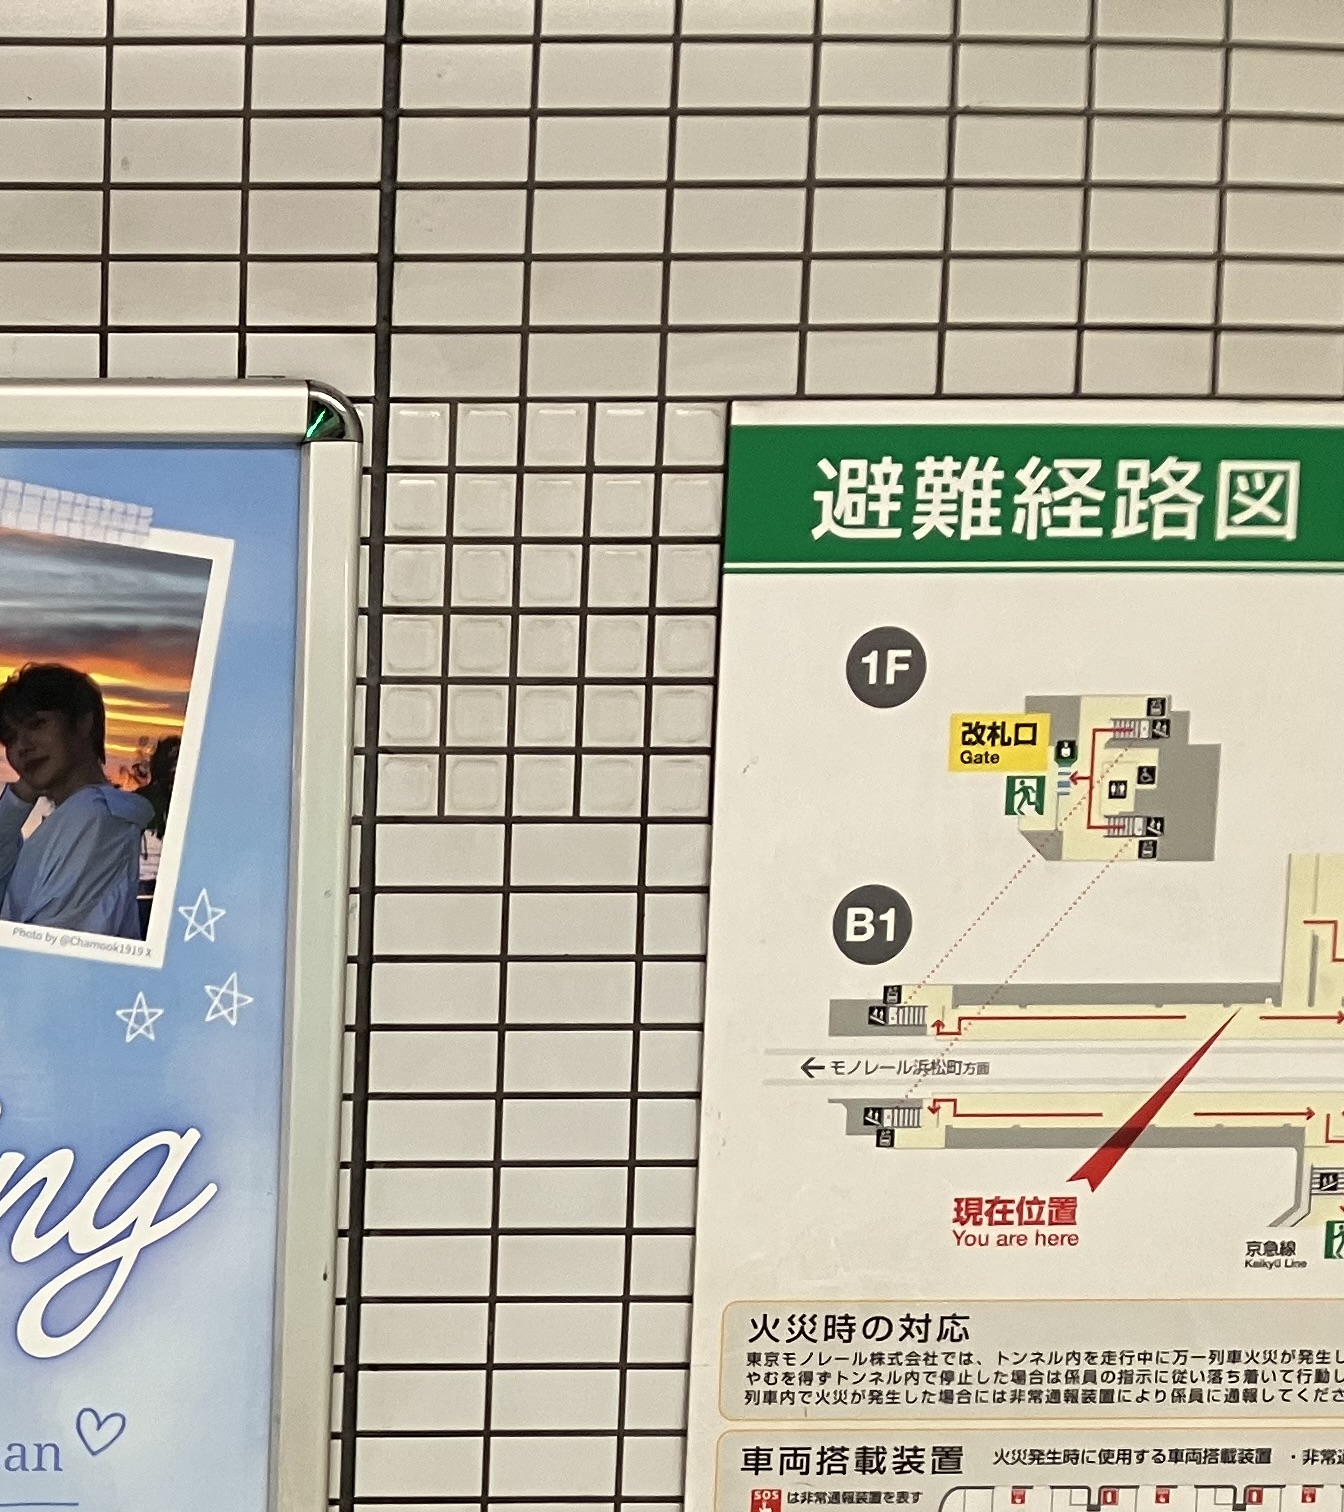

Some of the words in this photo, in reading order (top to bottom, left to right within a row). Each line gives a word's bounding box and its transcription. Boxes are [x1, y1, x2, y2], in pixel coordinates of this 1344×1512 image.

[811, 455, 1301, 542] 避難経路図
[861, 649, 913, 684] 1F
[961, 721, 1037, 747] 改札口
[959, 750, 1000, 765] Gate
[12, 926, 42, 941] Photo
[45, 931, 57, 946] by
[845, 908, 898, 942] B1
[830, 1058, 990, 1077] モノレール浜松町方面
[953, 1196, 1079, 1226] 現在位置
[953, 1230, 990, 1247] You
[996, 1234, 1028, 1247] are
[1034, 1230, 1079, 1247] here
[1246, 1240, 1296, 1257] 京急線
[748, 1313, 971, 1344] 火災時の対応
[740, 1446, 964, 1476] 車両搭載装置
[754, 1490, 779, 1501] SOS
